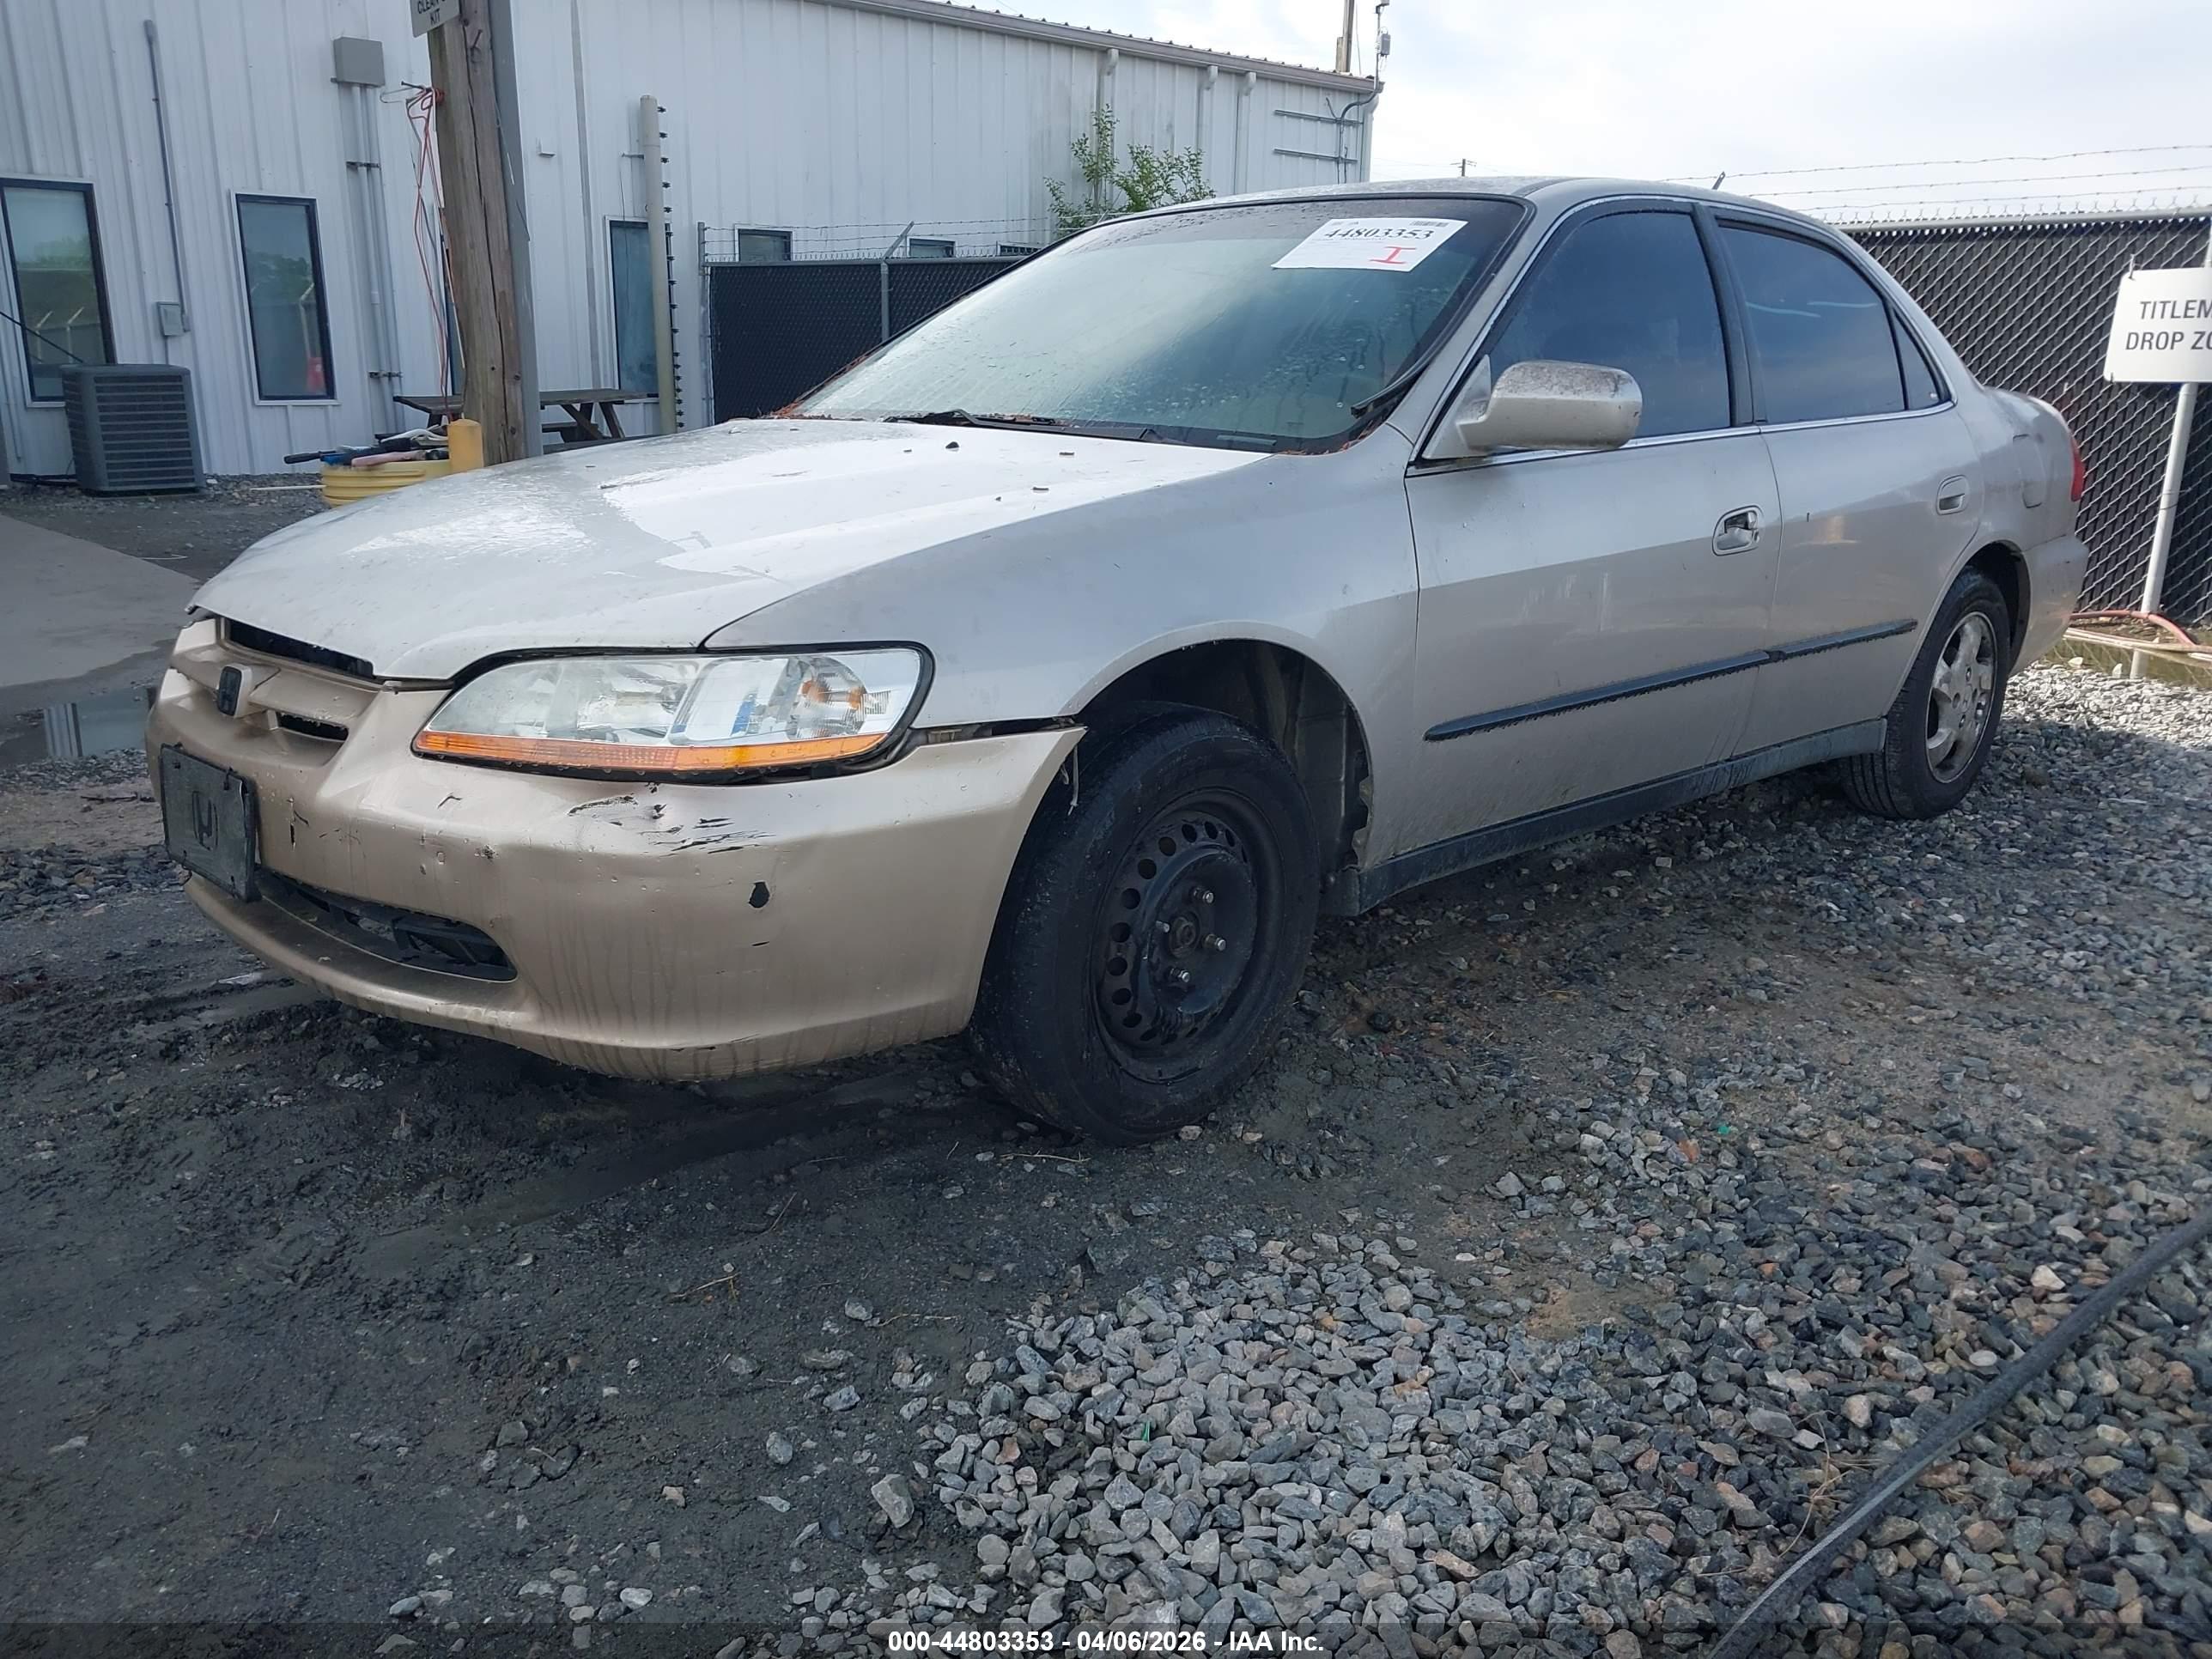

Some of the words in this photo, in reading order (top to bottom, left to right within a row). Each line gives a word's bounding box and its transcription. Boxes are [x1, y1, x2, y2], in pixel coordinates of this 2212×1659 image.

[1324, 228, 1435, 240] 44803353
[2140, 299, 2212, 319] TITLEM
[2125, 331, 2185, 350] DROP
